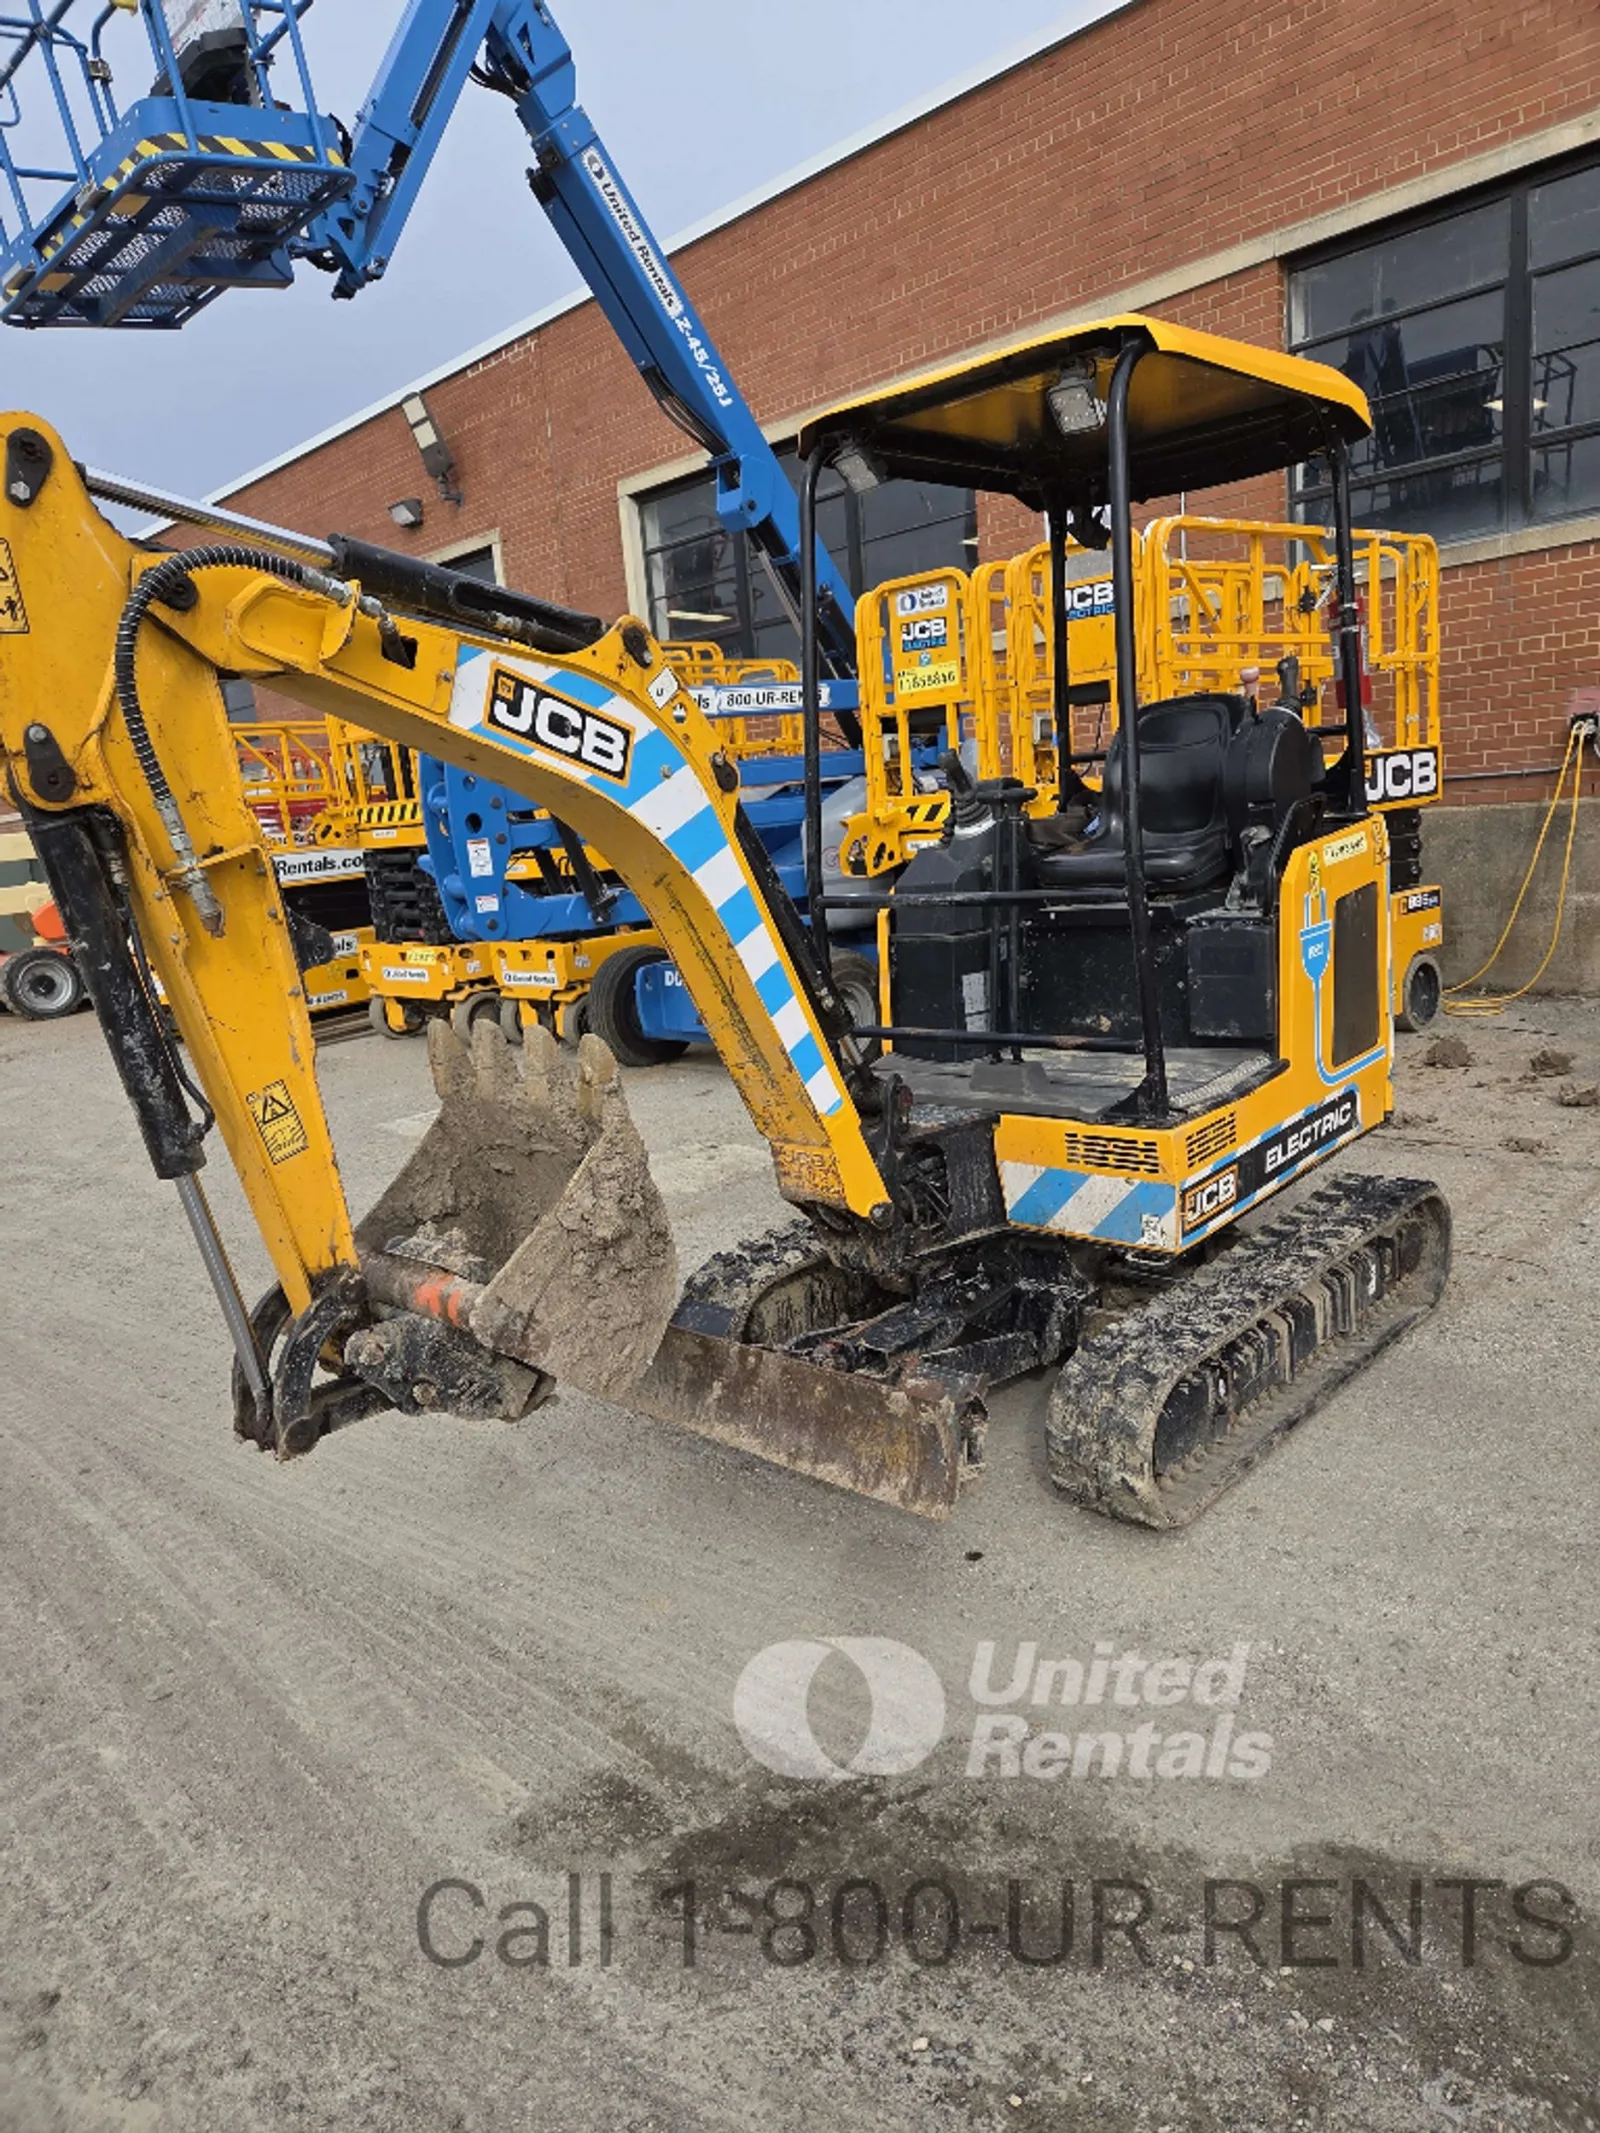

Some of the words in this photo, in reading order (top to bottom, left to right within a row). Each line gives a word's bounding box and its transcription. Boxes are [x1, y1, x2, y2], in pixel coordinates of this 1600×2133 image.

[602, 182, 640, 243] United
[637, 245, 674, 308] Rentals
[675, 316, 733, 408] Z-45/25J
[902, 618, 946, 641] JCB
[494, 686, 627, 773] JCB
[1365, 751, 1437, 801] JCB
[1187, 1172, 1235, 1222] JCB
[1264, 1101, 1352, 1174] ELECTRIC
